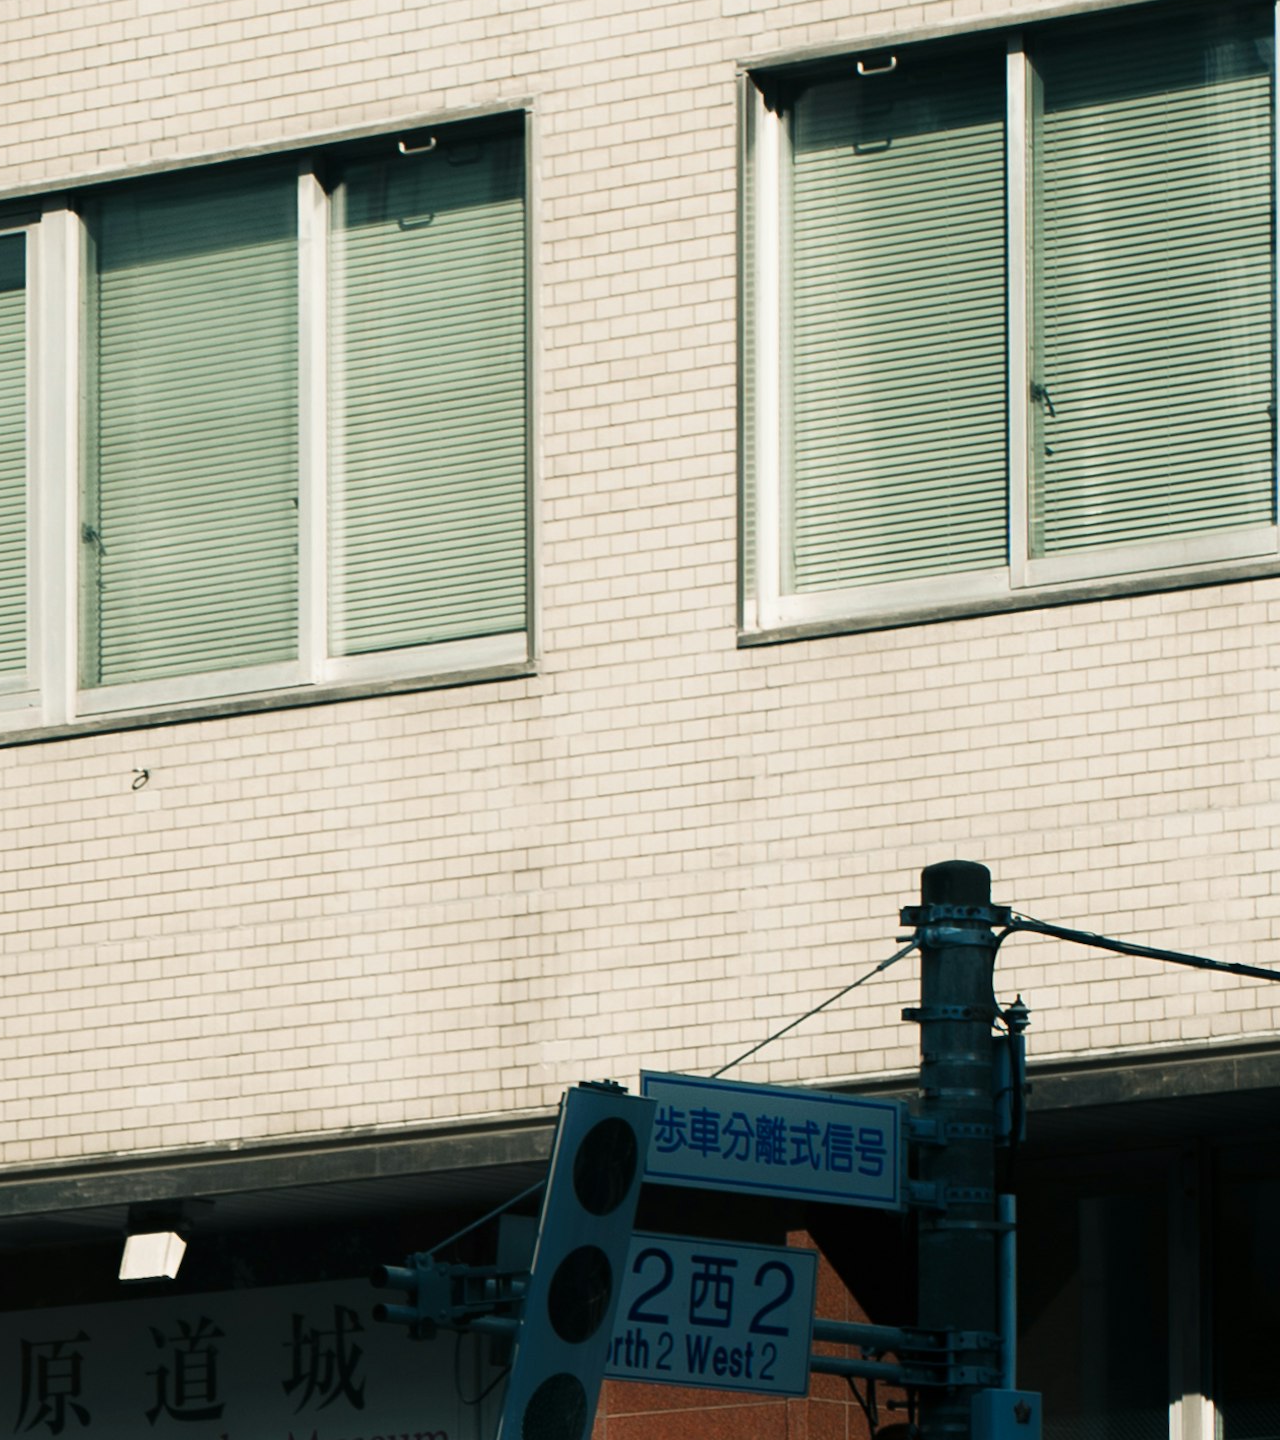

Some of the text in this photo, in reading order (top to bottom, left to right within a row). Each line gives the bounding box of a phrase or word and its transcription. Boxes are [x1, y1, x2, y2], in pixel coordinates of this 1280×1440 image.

[655, 1107, 886, 1177] 歩車分離式信号
[657, 1332, 674, 1371] 2
[686, 1335, 754, 1379] West
[760, 1342, 777, 1380] 2
